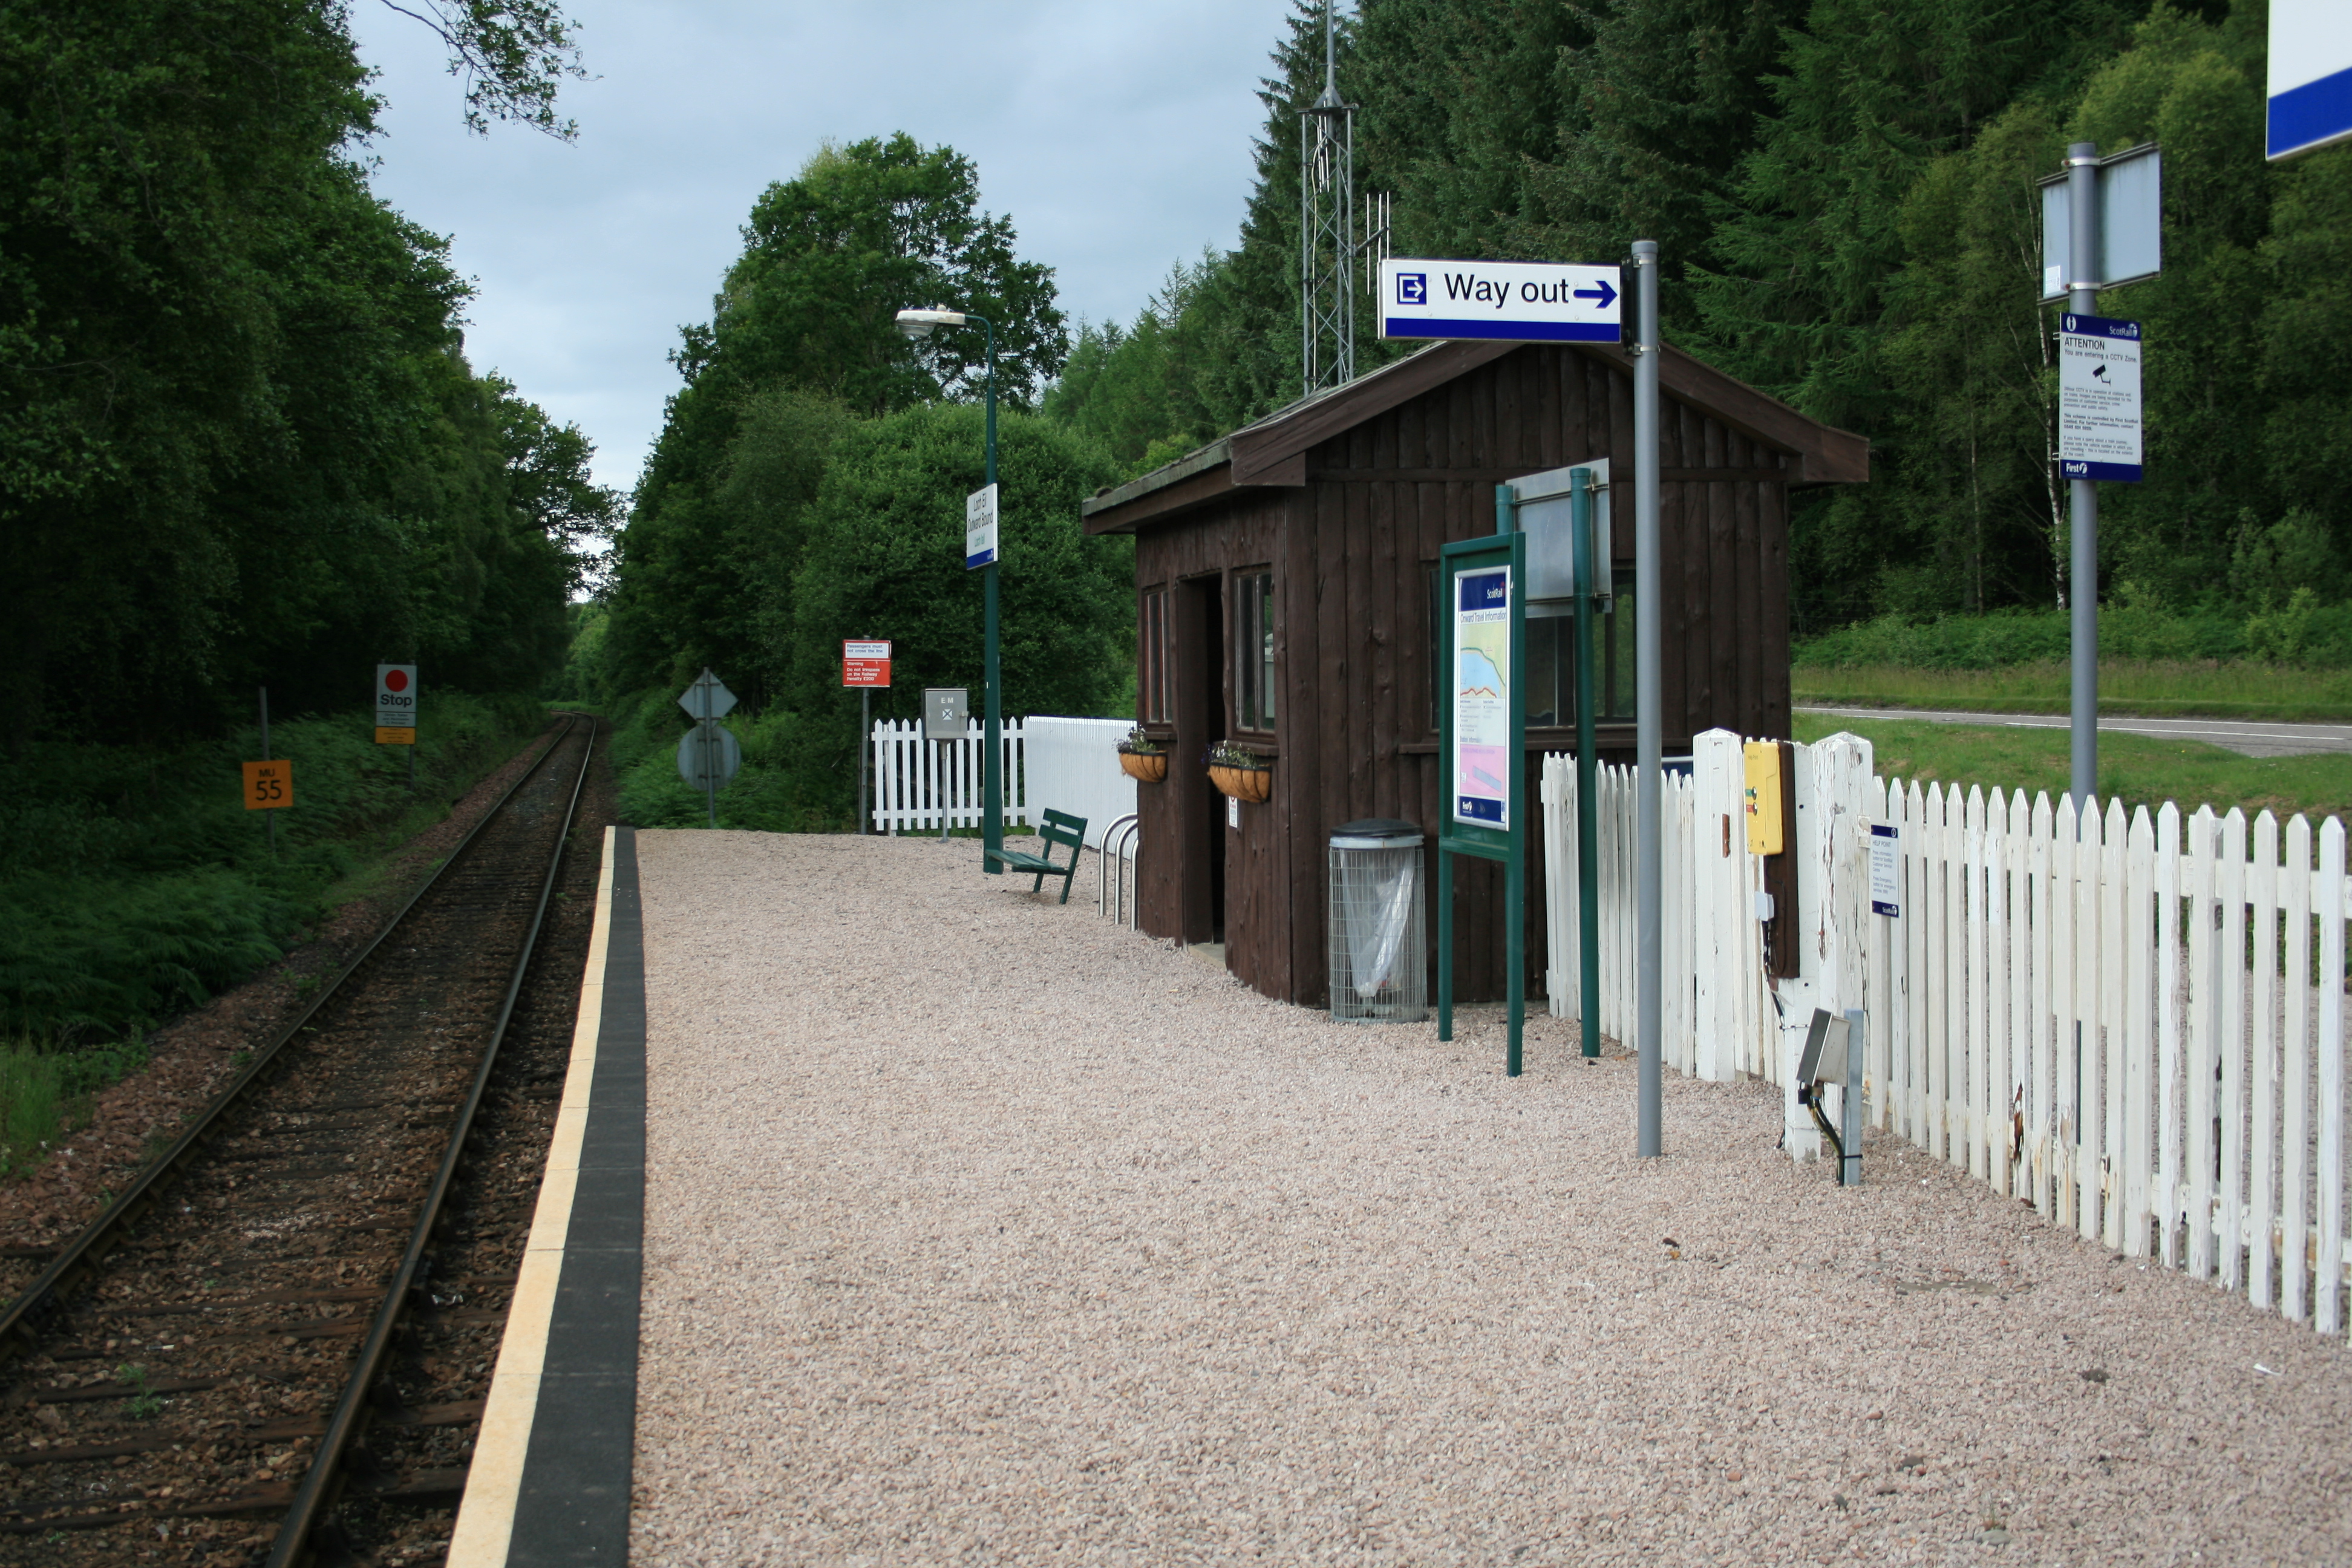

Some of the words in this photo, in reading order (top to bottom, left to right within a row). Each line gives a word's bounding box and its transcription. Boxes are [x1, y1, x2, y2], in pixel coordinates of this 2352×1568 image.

[1444, 273, 1510, 309] Way
[1521, 278, 1569, 303] out
[2109, 325, 2132, 338] ScotRail
[2064, 337, 2105, 350] ATTENTION
[2085, 351, 2104, 360] entering
[2066, 463, 2079, 473] First
[973, 495, 982, 512] Loch
[967, 514, 981, 533] Outward
[982, 508, 993, 527] Bound
[1487, 588, 1503, 599] ScotRail
[1460, 613, 1474, 623] Onward
[1474, 612, 1485, 622] Travel
[1485, 610, 1506, 621] Information
[381, 694, 413, 708] Stop
[258, 768, 275, 777] MU
[255, 779, 283, 802] 55
